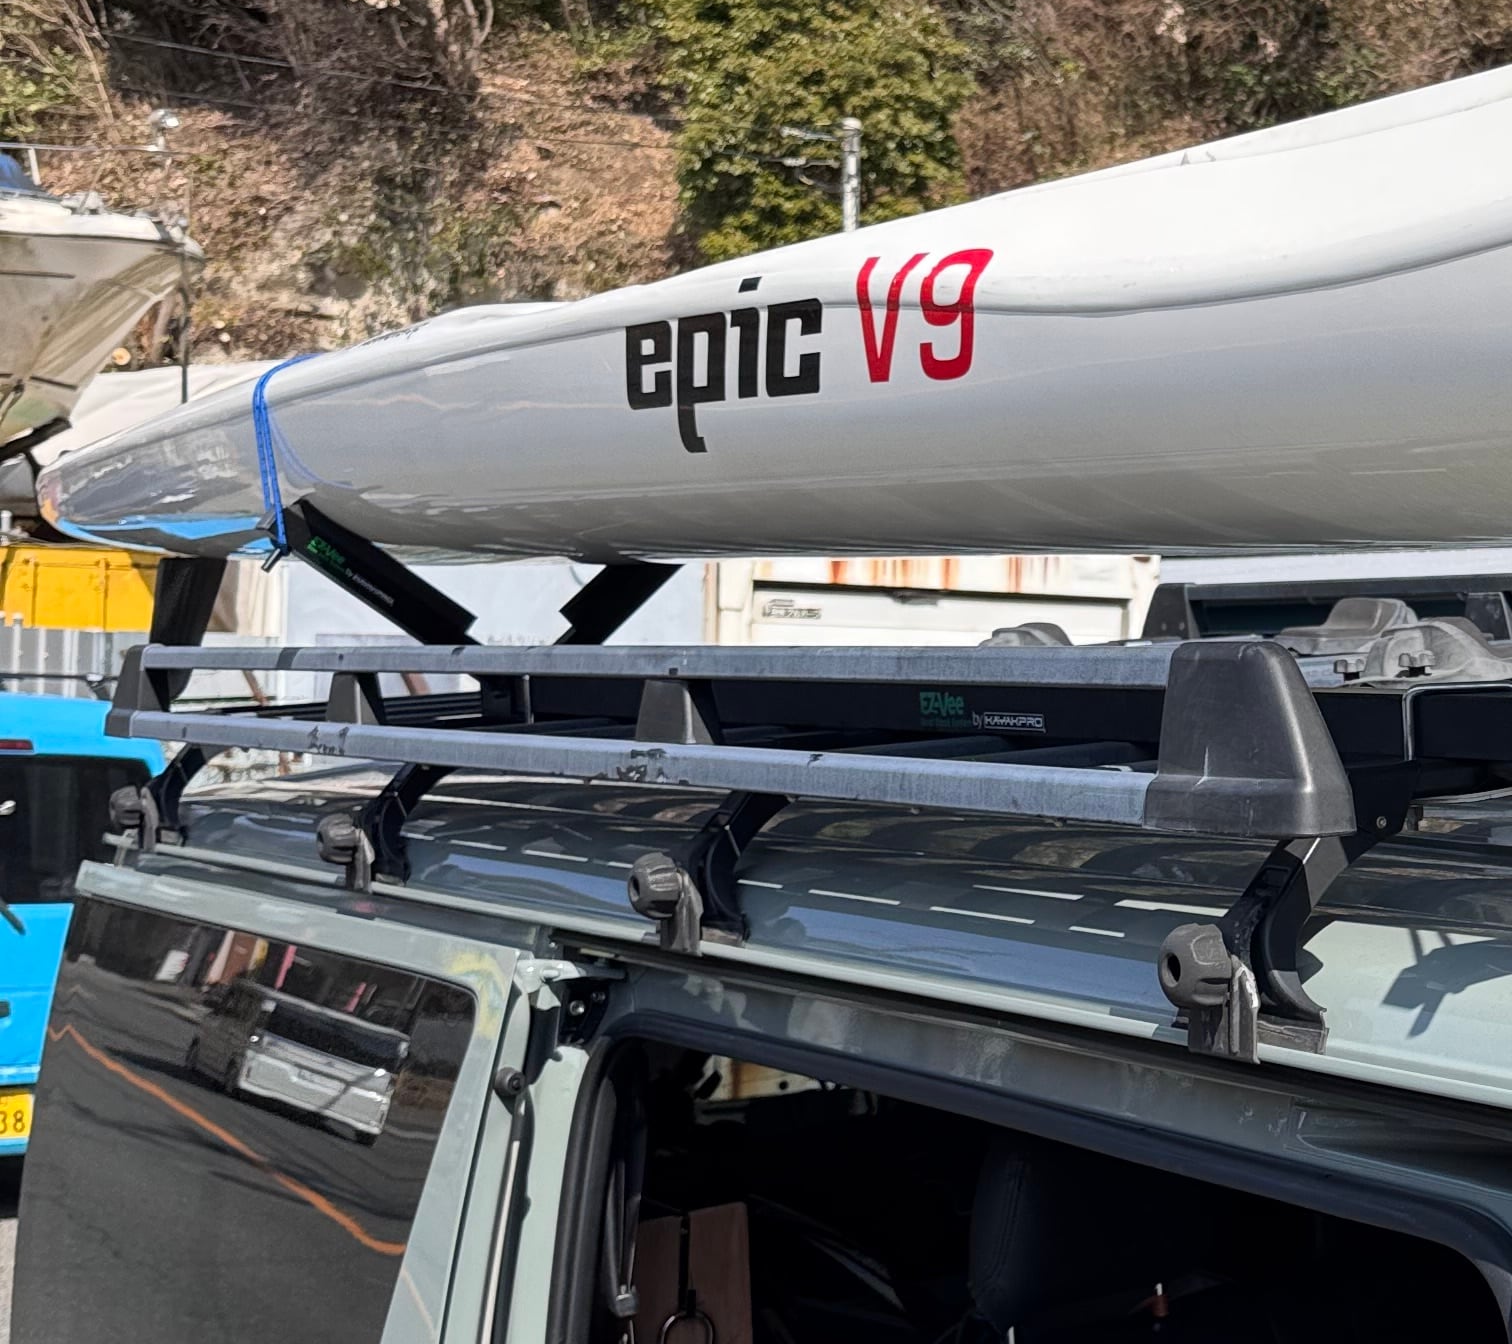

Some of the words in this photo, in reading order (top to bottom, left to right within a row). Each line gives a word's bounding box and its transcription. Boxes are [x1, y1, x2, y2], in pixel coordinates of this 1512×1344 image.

[625, 276, 823, 453] epic
[855, 248, 994, 384] V9
[972, 711, 984, 729] by
[984, 714, 1045, 730] KAYAKPRO
